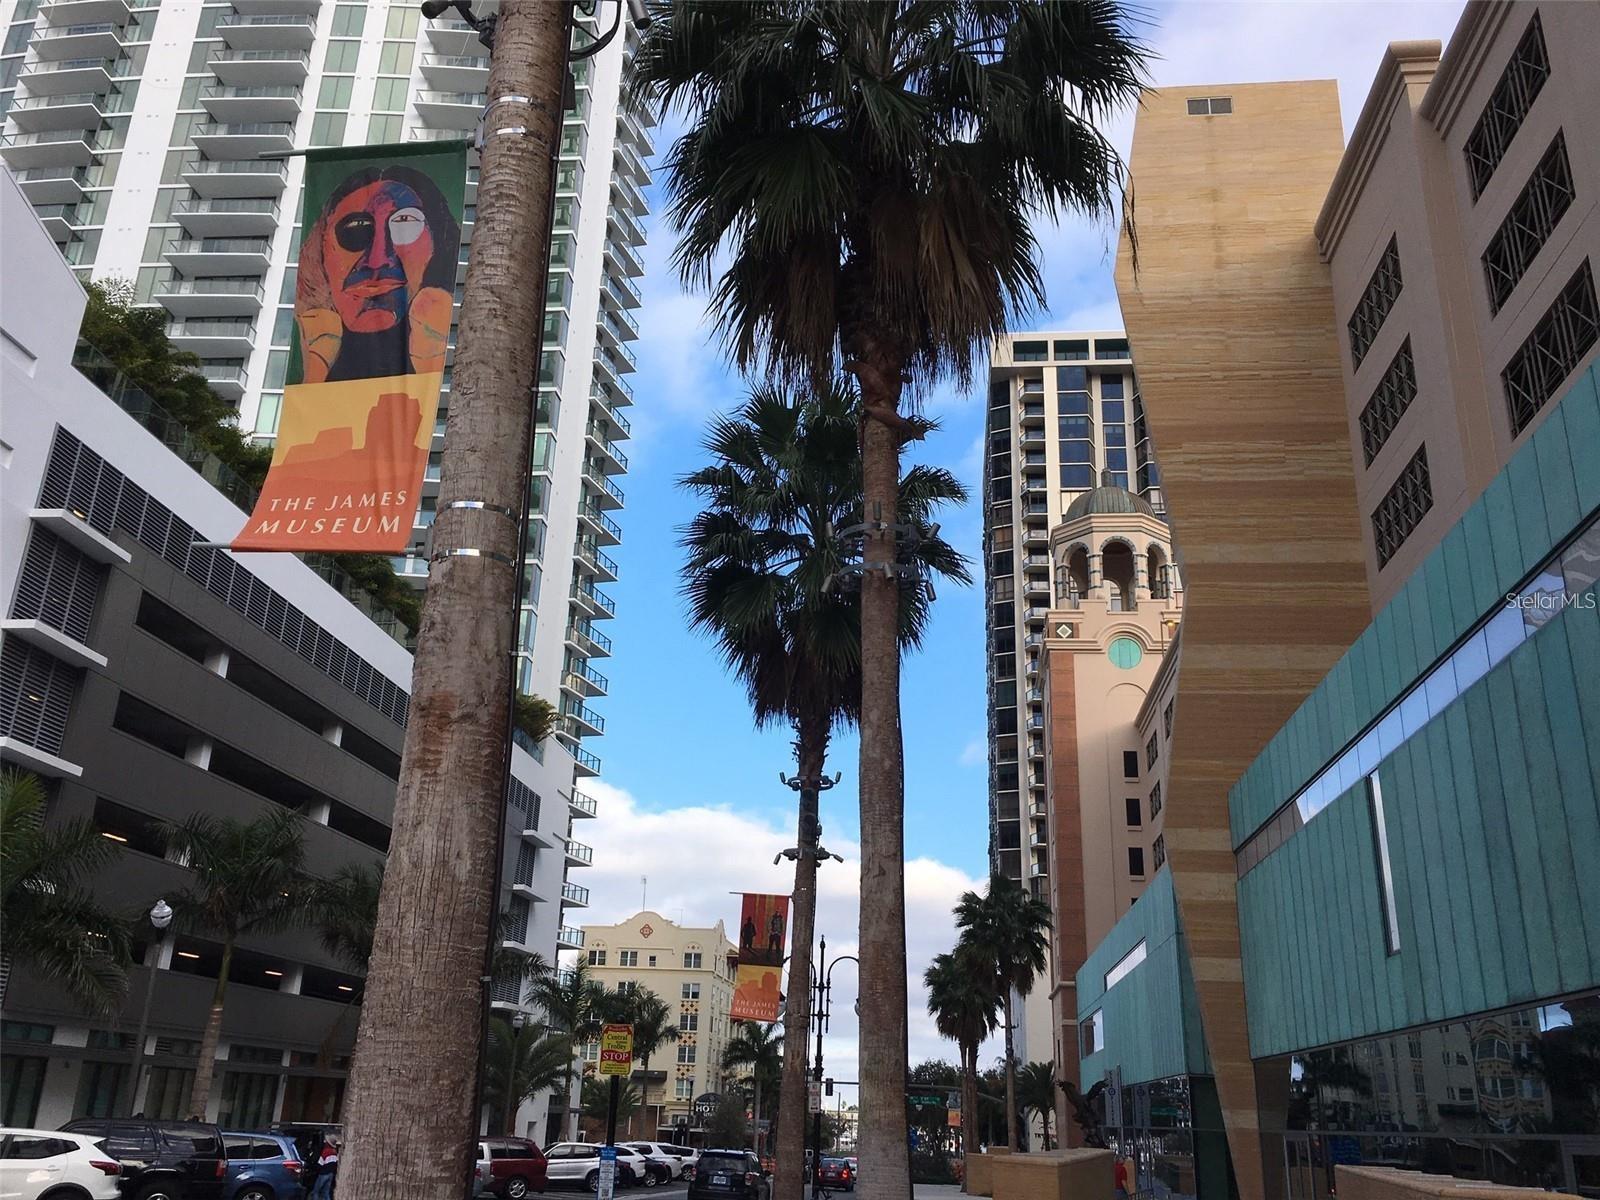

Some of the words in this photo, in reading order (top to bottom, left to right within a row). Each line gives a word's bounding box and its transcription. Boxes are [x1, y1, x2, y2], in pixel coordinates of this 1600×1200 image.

[270, 496, 316, 511] THE
[325, 490, 407, 511] JAMES
[254, 515, 400, 534] MUSEUM
[735, 1007, 775, 1018] MUSEUM
[607, 1033, 628, 1041] Central
[607, 1042, 626, 1050] Trolley
[602, 1051, 629, 1061] STOP
